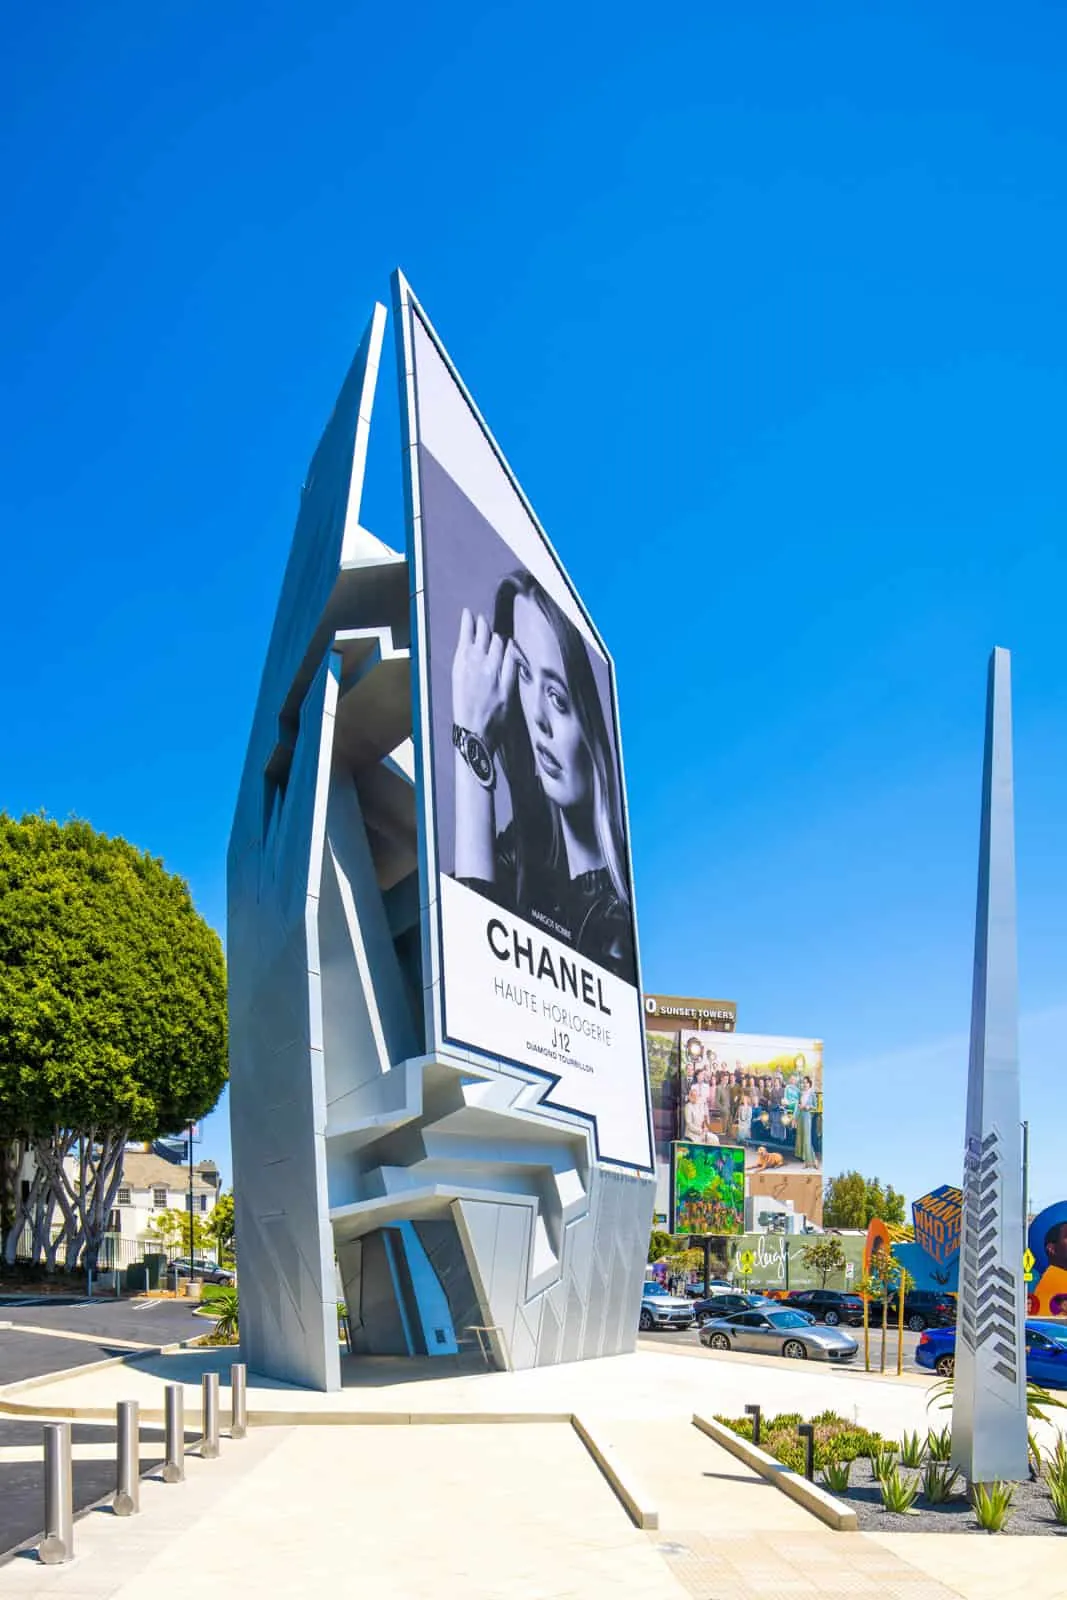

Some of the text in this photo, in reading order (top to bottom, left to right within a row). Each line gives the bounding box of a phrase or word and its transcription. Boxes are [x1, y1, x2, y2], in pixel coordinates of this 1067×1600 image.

[487, 918, 612, 1016] CHANEL
[494, 976, 613, 1046] HAUTE HORLOGERIE
[660, 1006, 697, 1017] SUNSET
[698, 1008, 734, 1019] TOWERS
[526, 1041, 594, 1073] DIAMOND TOURBILLON
[552, 1027, 571, 1053] J12
[914, 1195, 962, 1222] MAN
[914, 1207, 945, 1244] WHO
[915, 1227, 944, 1265] FELL
